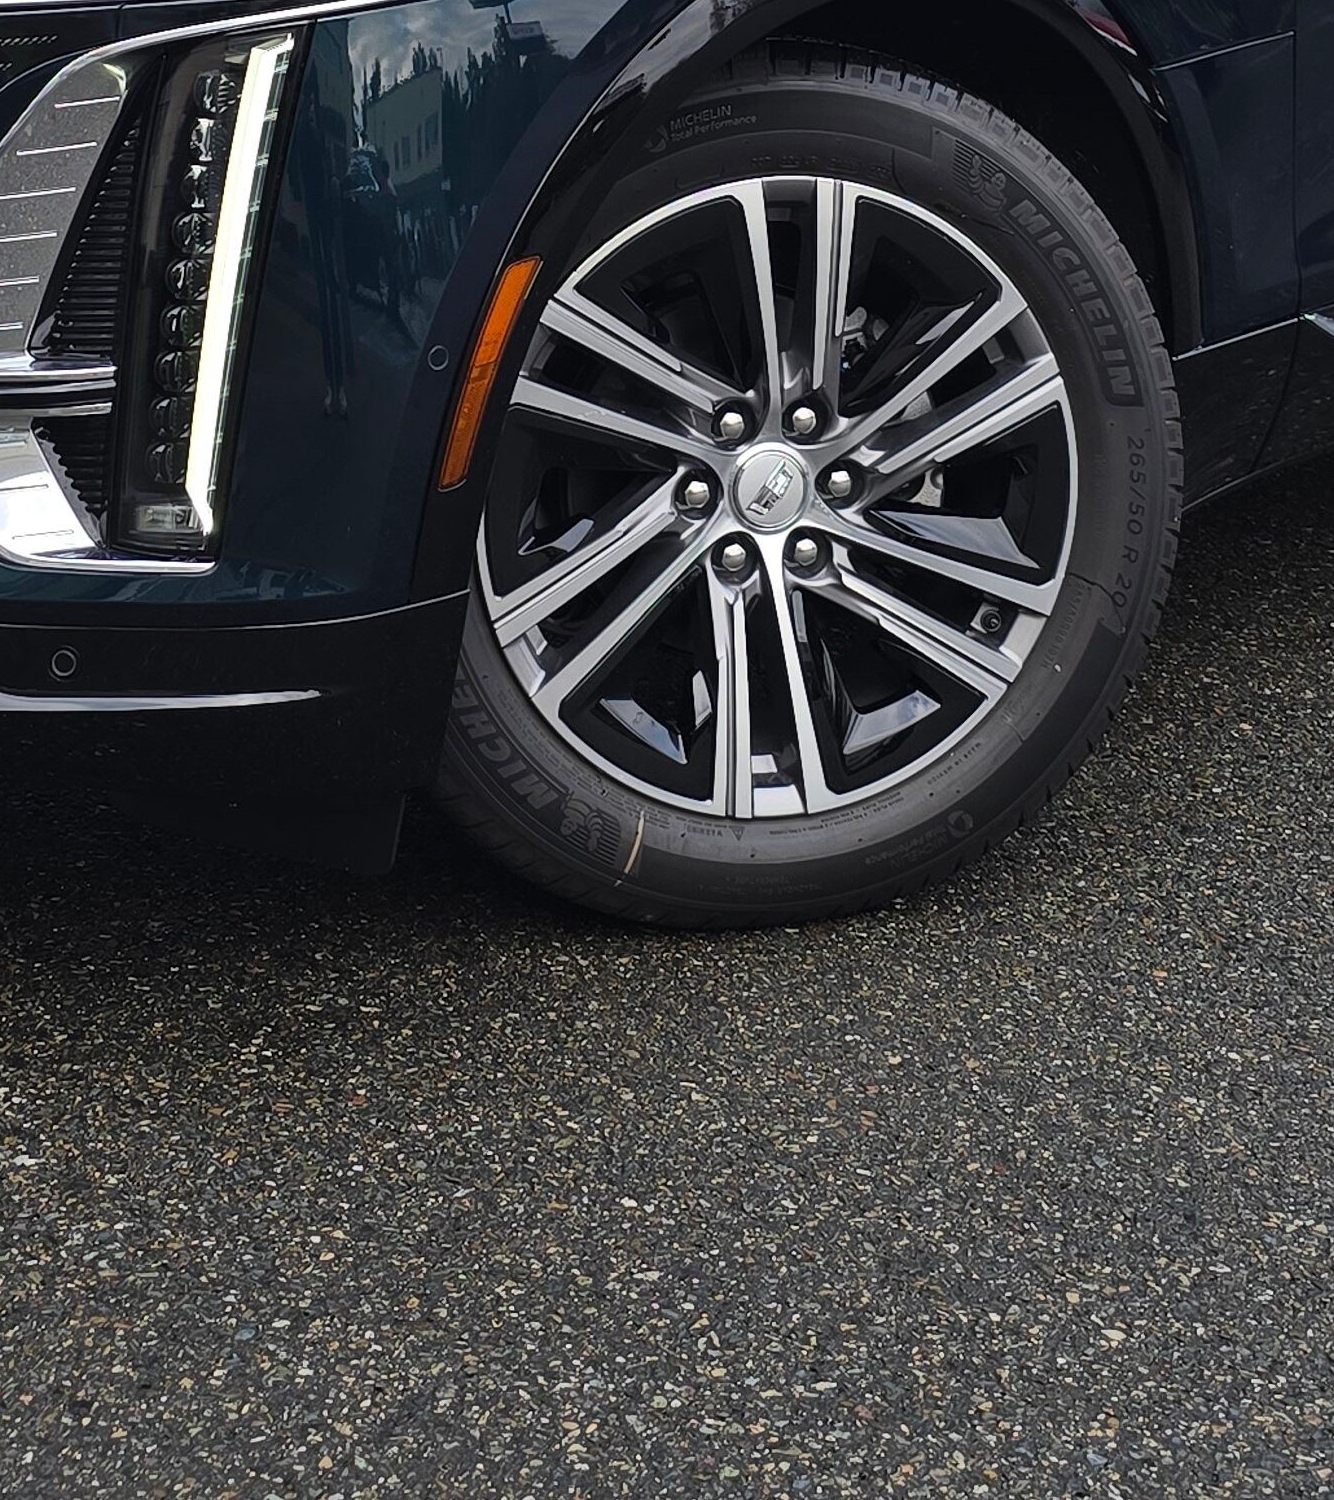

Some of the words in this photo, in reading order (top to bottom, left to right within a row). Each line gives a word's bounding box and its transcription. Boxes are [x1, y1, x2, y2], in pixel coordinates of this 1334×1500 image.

[670, 104, 732, 132] MICHELIN
[694, 115, 757, 135] Performance
[1008, 199, 1136, 397] MICHELIN
[1126, 435, 1147, 536] 265/50
[1121, 544, 1139, 565] R
[1112, 572, 1133, 609] 20
